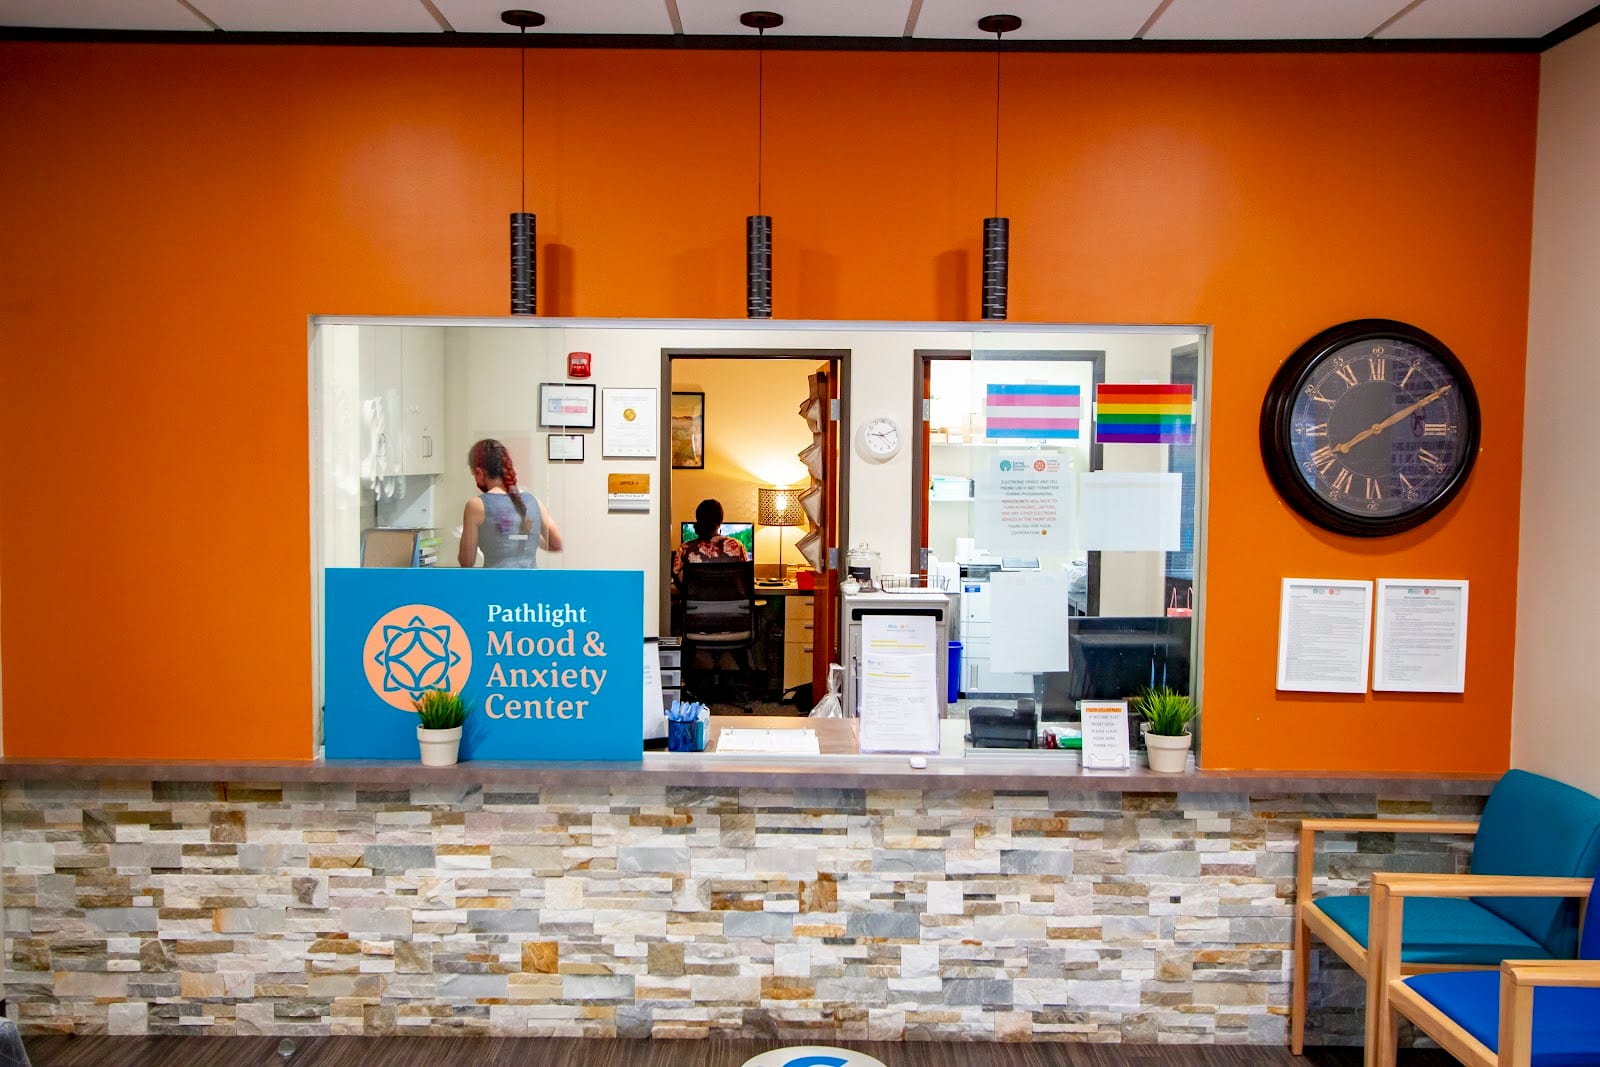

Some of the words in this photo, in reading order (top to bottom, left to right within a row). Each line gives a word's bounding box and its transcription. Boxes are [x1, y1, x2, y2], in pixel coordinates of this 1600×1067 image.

[1336, 364, 1358, 389] XI
[1367, 358, 1385, 382] XII
[1305, 422, 1328, 437] IX
[1424, 423, 1447, 436] III
[1310, 445, 1336, 475] VIII
[1332, 467, 1354, 494] VII
[1366, 477, 1382, 500] VI
[488, 602, 587, 628] Pathlight
[486, 628, 576, 657] Mood
[582, 630, 608, 657] &
[486, 661, 607, 695] Anxiety
[485, 693, 589, 720] Center
